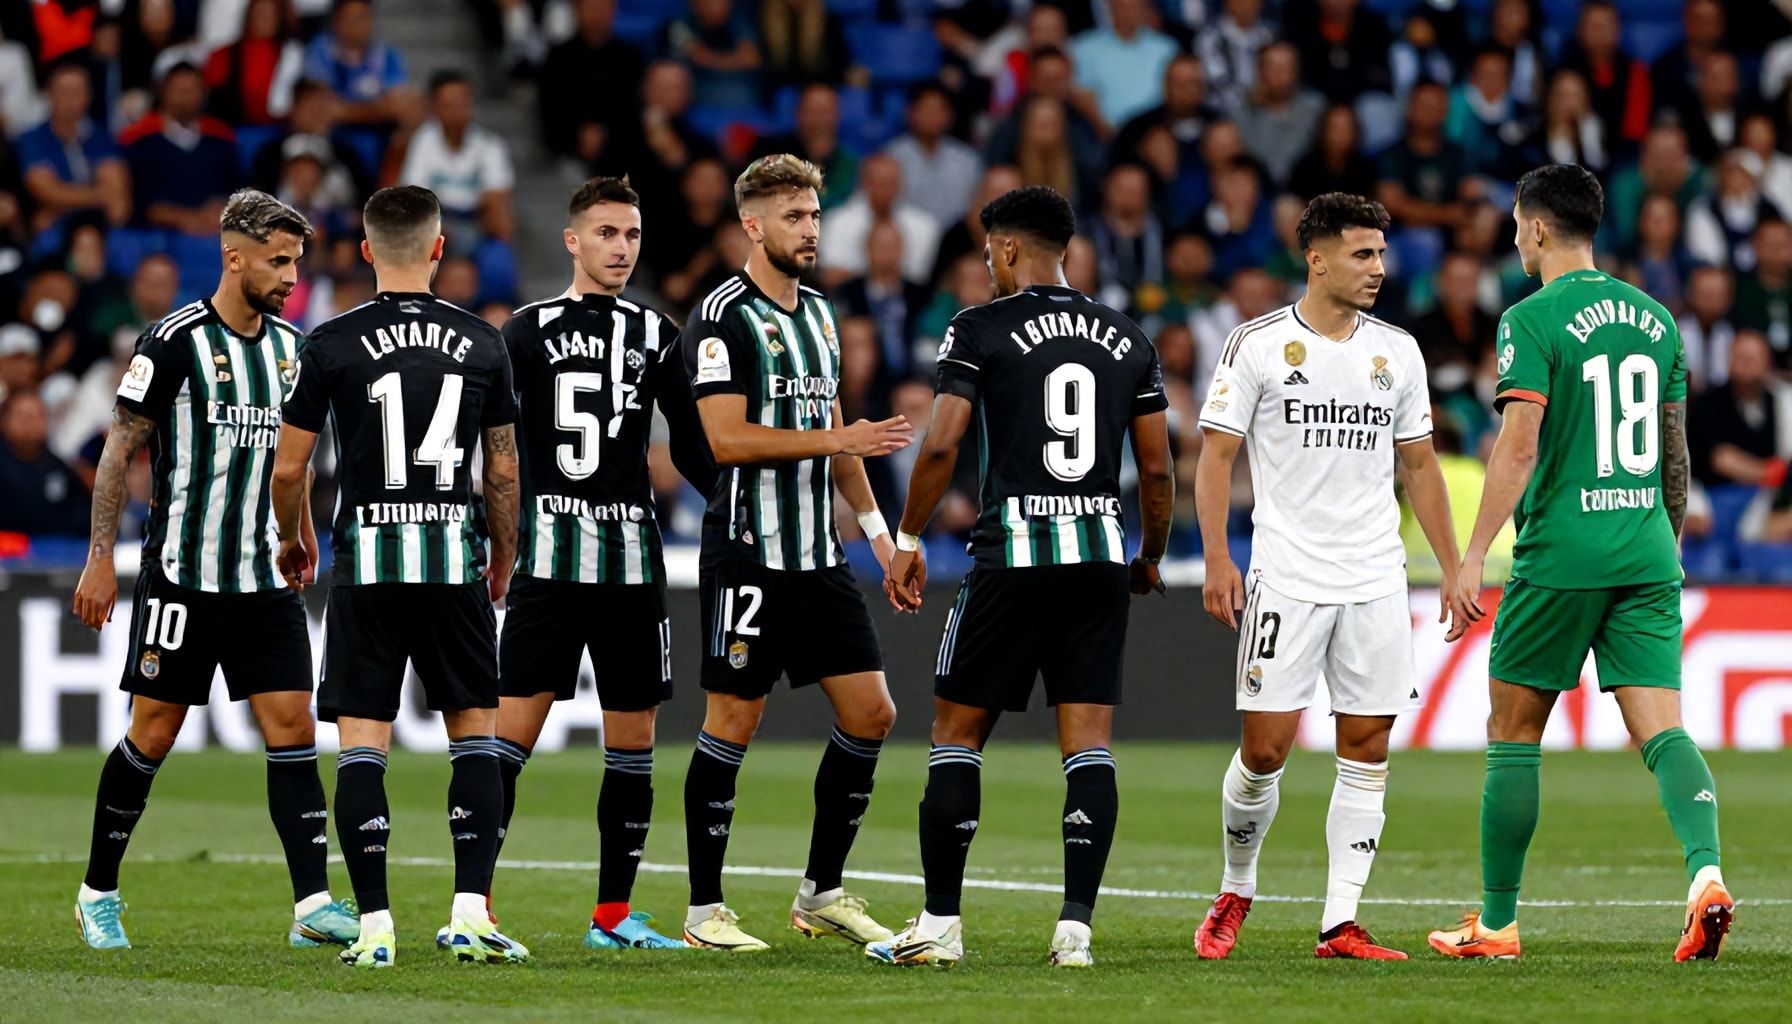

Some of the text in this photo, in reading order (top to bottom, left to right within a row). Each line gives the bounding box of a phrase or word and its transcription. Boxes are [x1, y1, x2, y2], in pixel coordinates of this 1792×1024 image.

[367, 372, 464, 491] 14
[554, 371, 603, 481] 5
[1042, 362, 1097, 482] 9
[1582, 353, 1659, 478] 18
[145, 598, 188, 651] 10
[724, 585, 763, 636] 12
